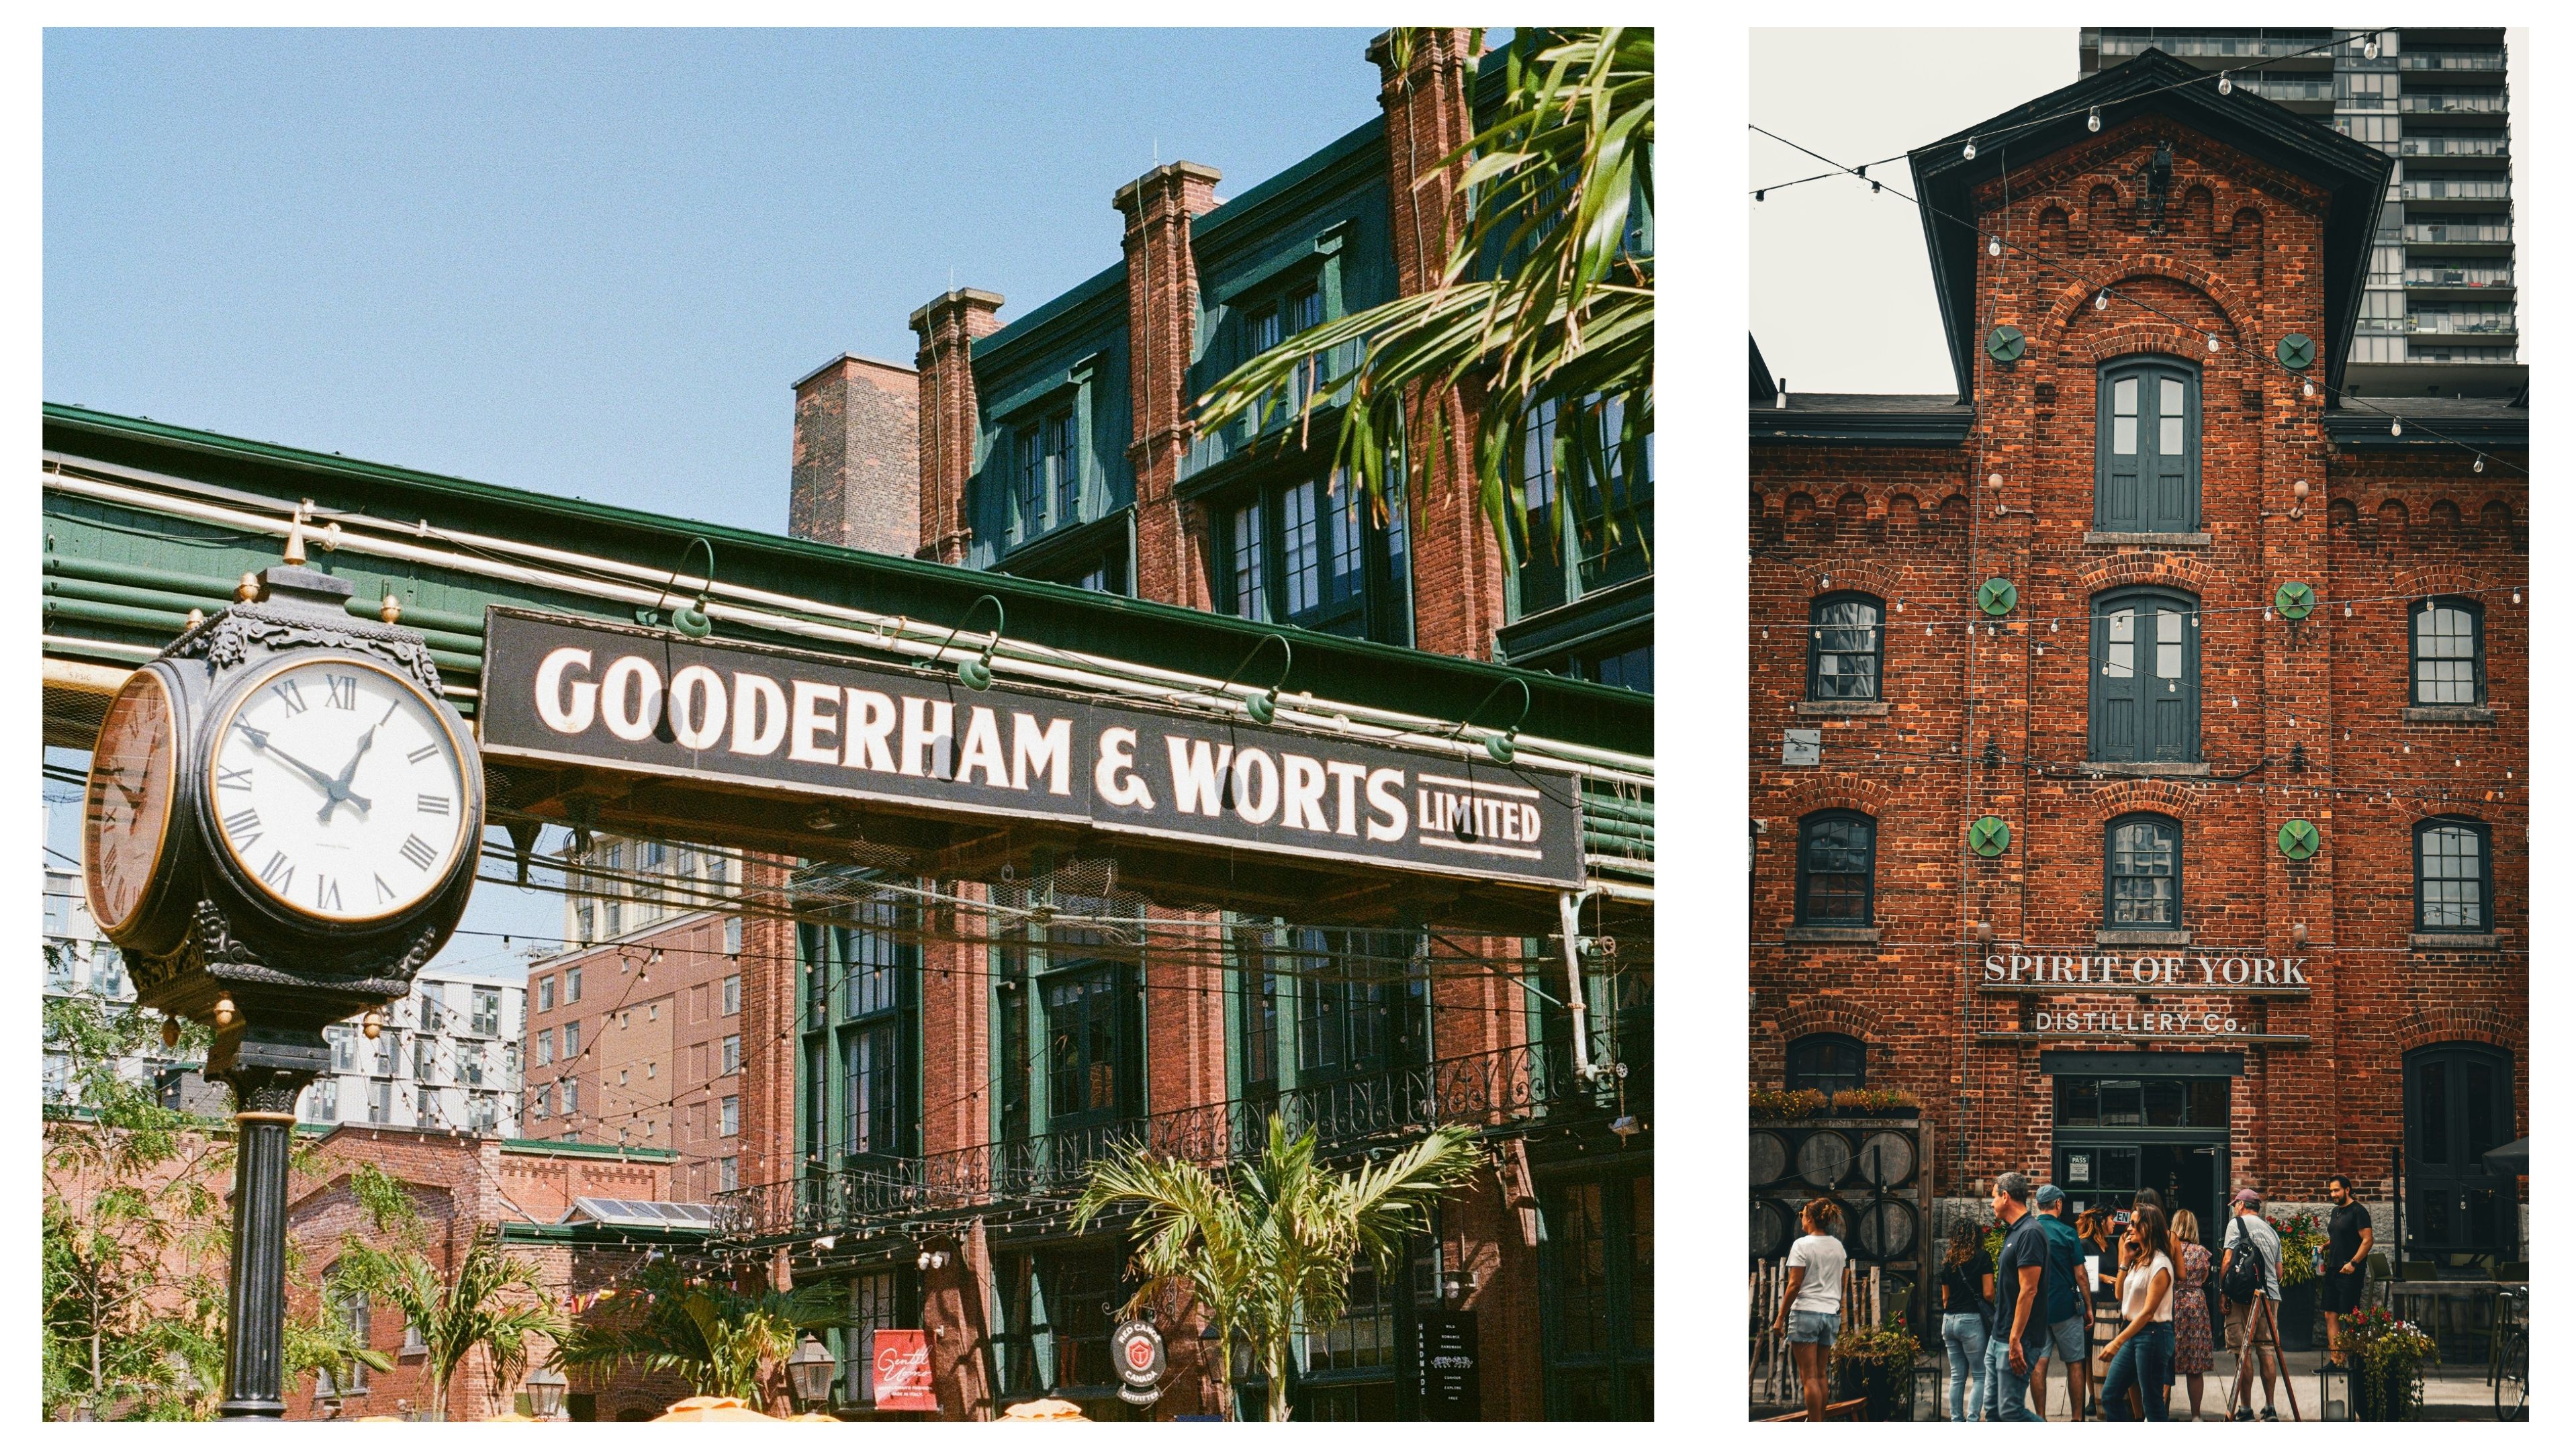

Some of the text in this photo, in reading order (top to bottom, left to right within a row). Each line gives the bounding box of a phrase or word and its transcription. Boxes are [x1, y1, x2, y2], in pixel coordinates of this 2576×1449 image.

[272, 678, 308, 718] XI
[325, 673, 357, 711] XII
[407, 743, 440, 764] II
[535, 647, 1541, 843] GOODERHAM & WORTS LIMITED
[218, 764, 253, 792] IX
[417, 794, 449, 816] III
[224, 807, 263, 854] VIII
[399, 833, 438, 872] IIII
[261, 850, 297, 896] VII
[373, 871, 396, 904] V
[318, 874, 343, 911] VI
[1984, 954, 2309, 985] SPIRIT OF YORK
[2036, 1012, 2246, 1033] DISTILLERY Co.
[2117, 1211, 2129, 1222] EN
[1118, 1323, 1162, 1344] RED CANOE
[1125, 1370, 1158, 1383] CANADA
[1121, 1391, 1159, 1401] OUTFITTER
